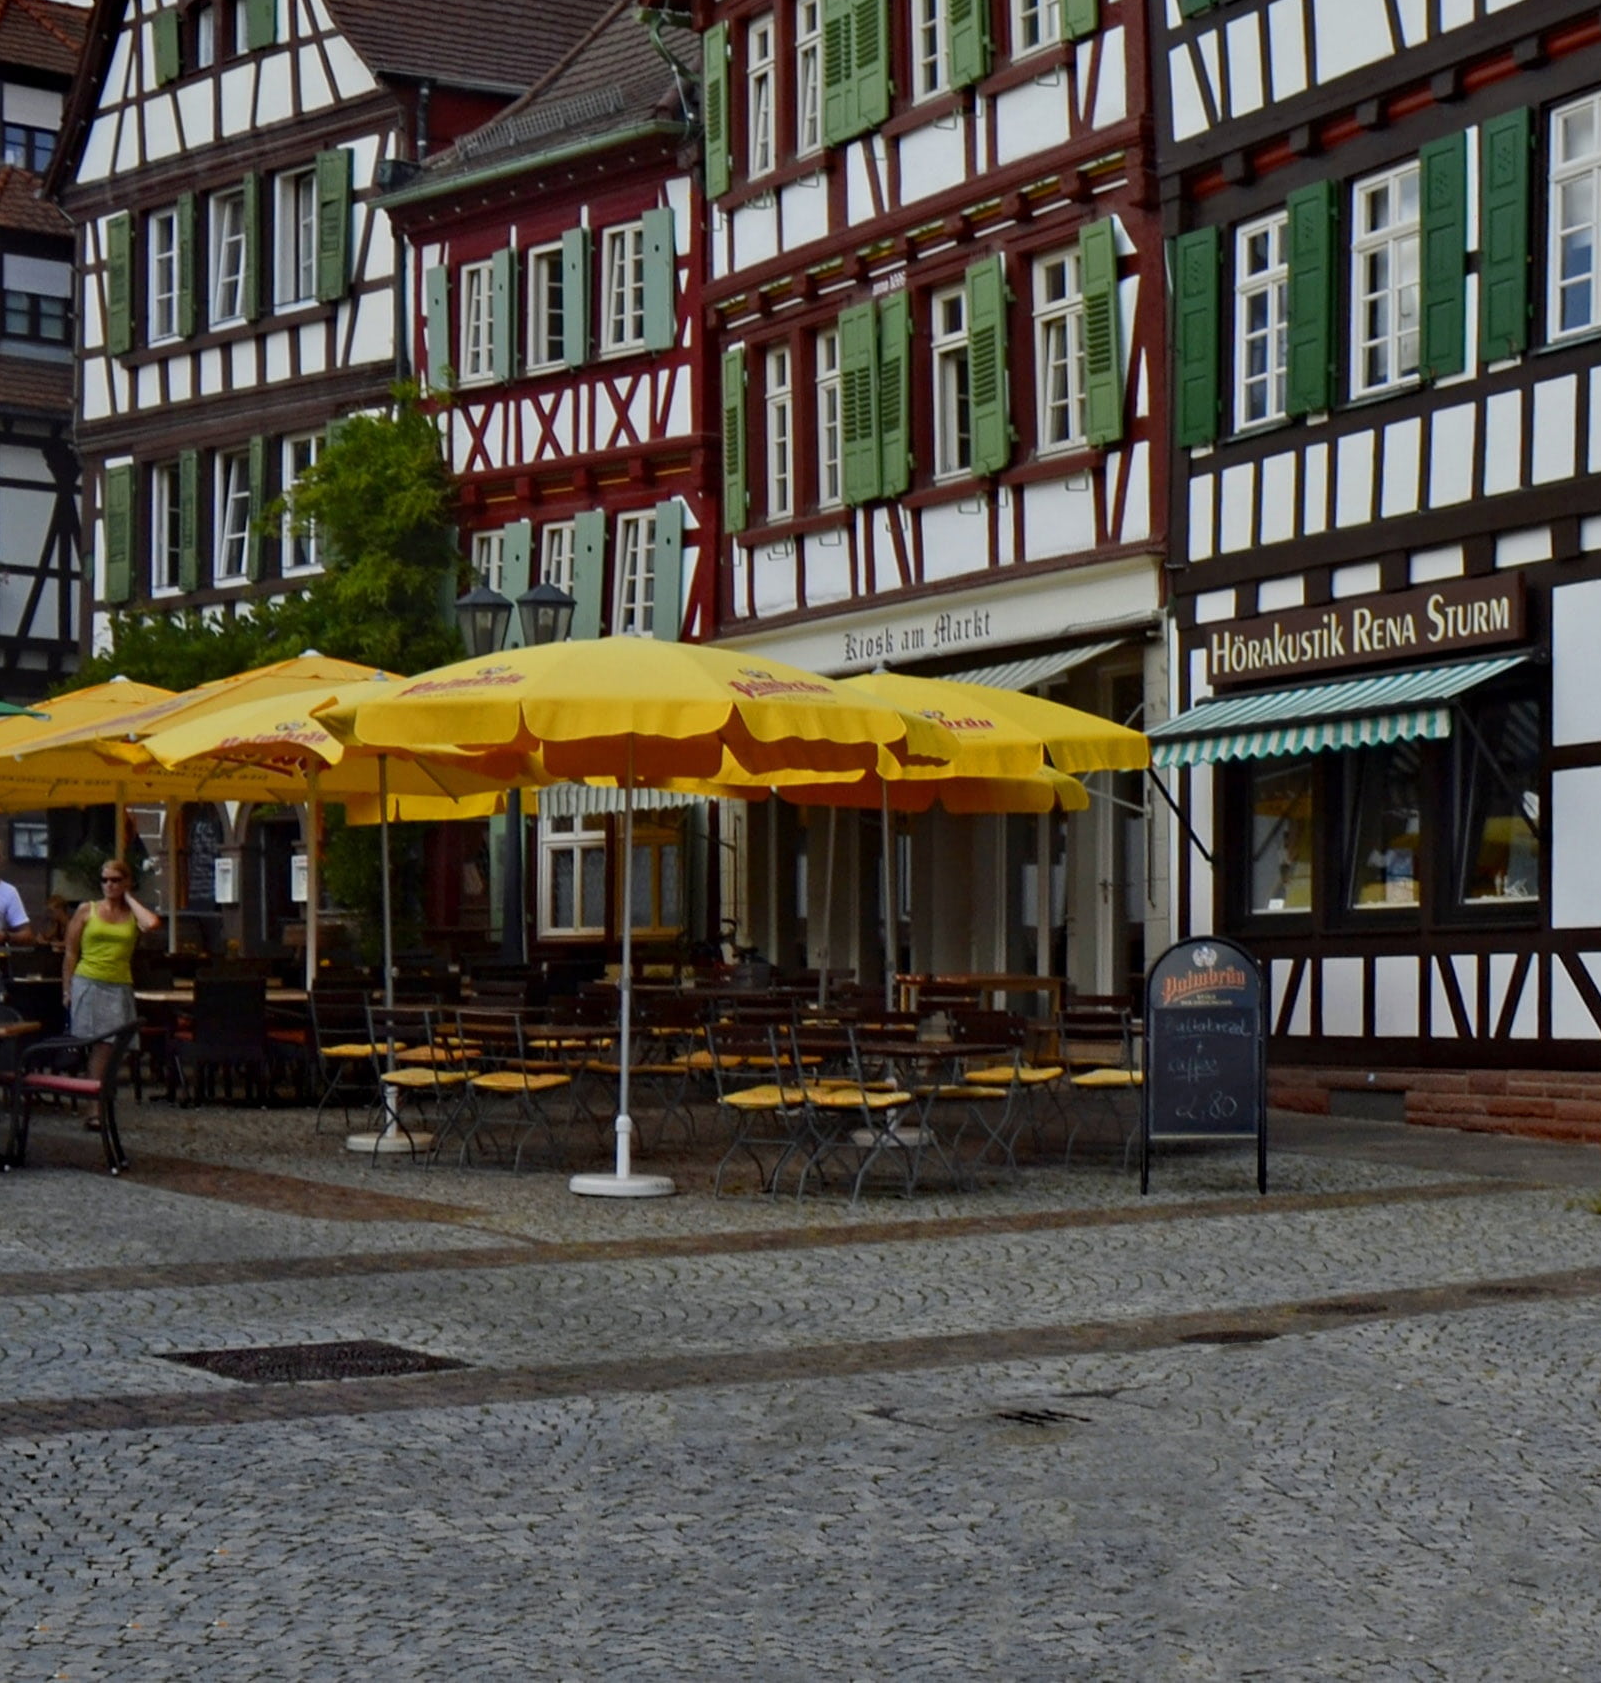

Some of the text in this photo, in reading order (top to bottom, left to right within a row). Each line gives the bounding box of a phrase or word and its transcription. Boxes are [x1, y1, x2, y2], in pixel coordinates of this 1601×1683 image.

[843, 609, 991, 663] Kiosk am Markt
